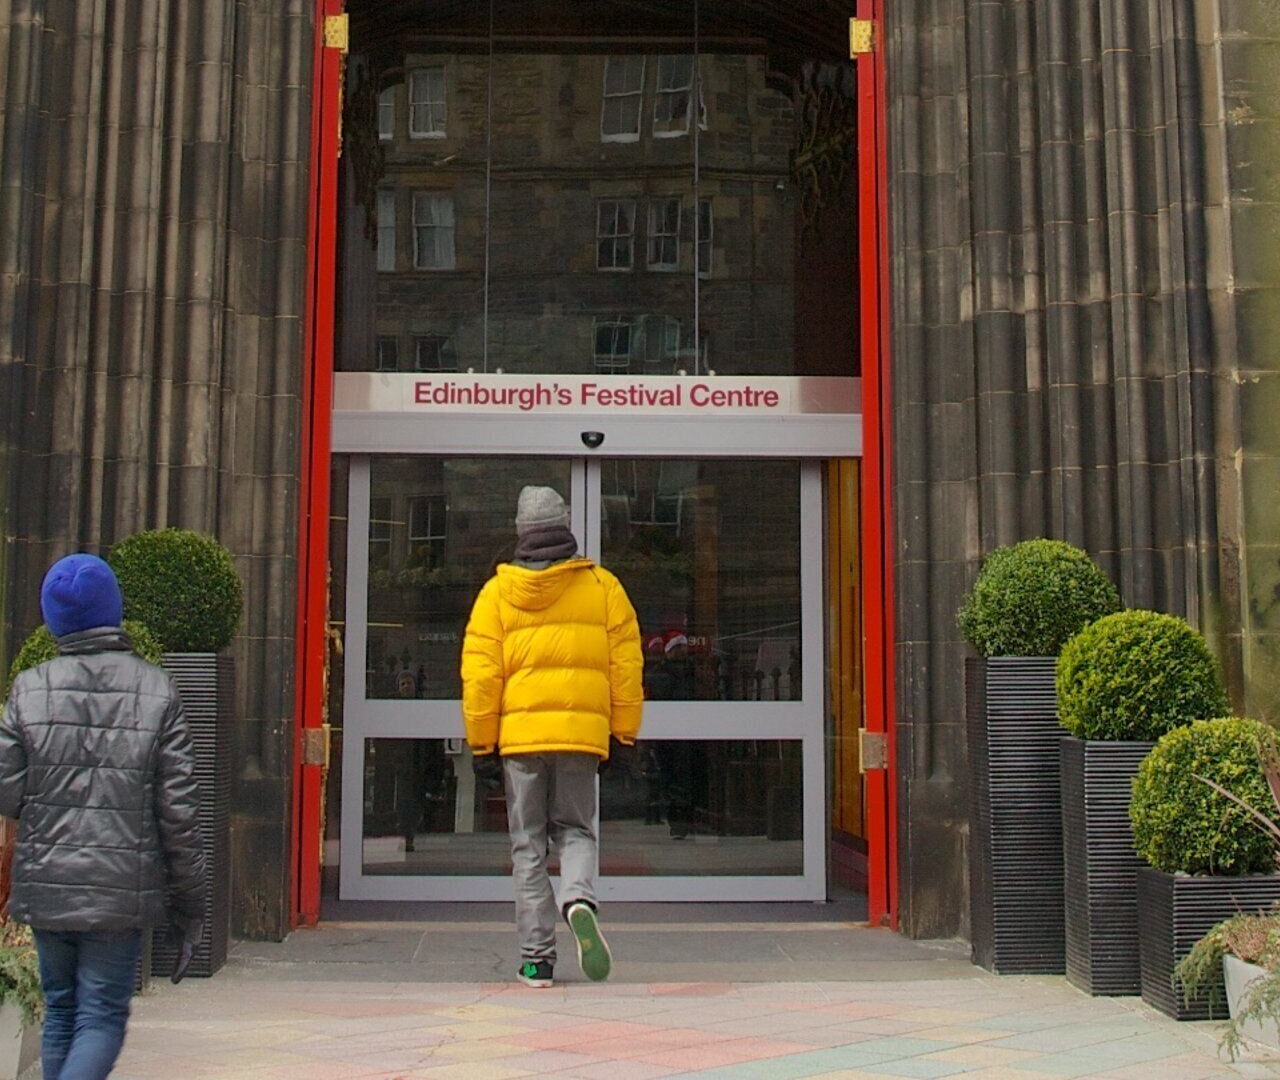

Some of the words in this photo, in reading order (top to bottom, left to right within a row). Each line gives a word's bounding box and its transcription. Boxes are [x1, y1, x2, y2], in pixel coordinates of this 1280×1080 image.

[414, 381, 573, 410] Edinburgh's
[581, 383, 681, 407] Festival
[689, 383, 780, 408] Centre
